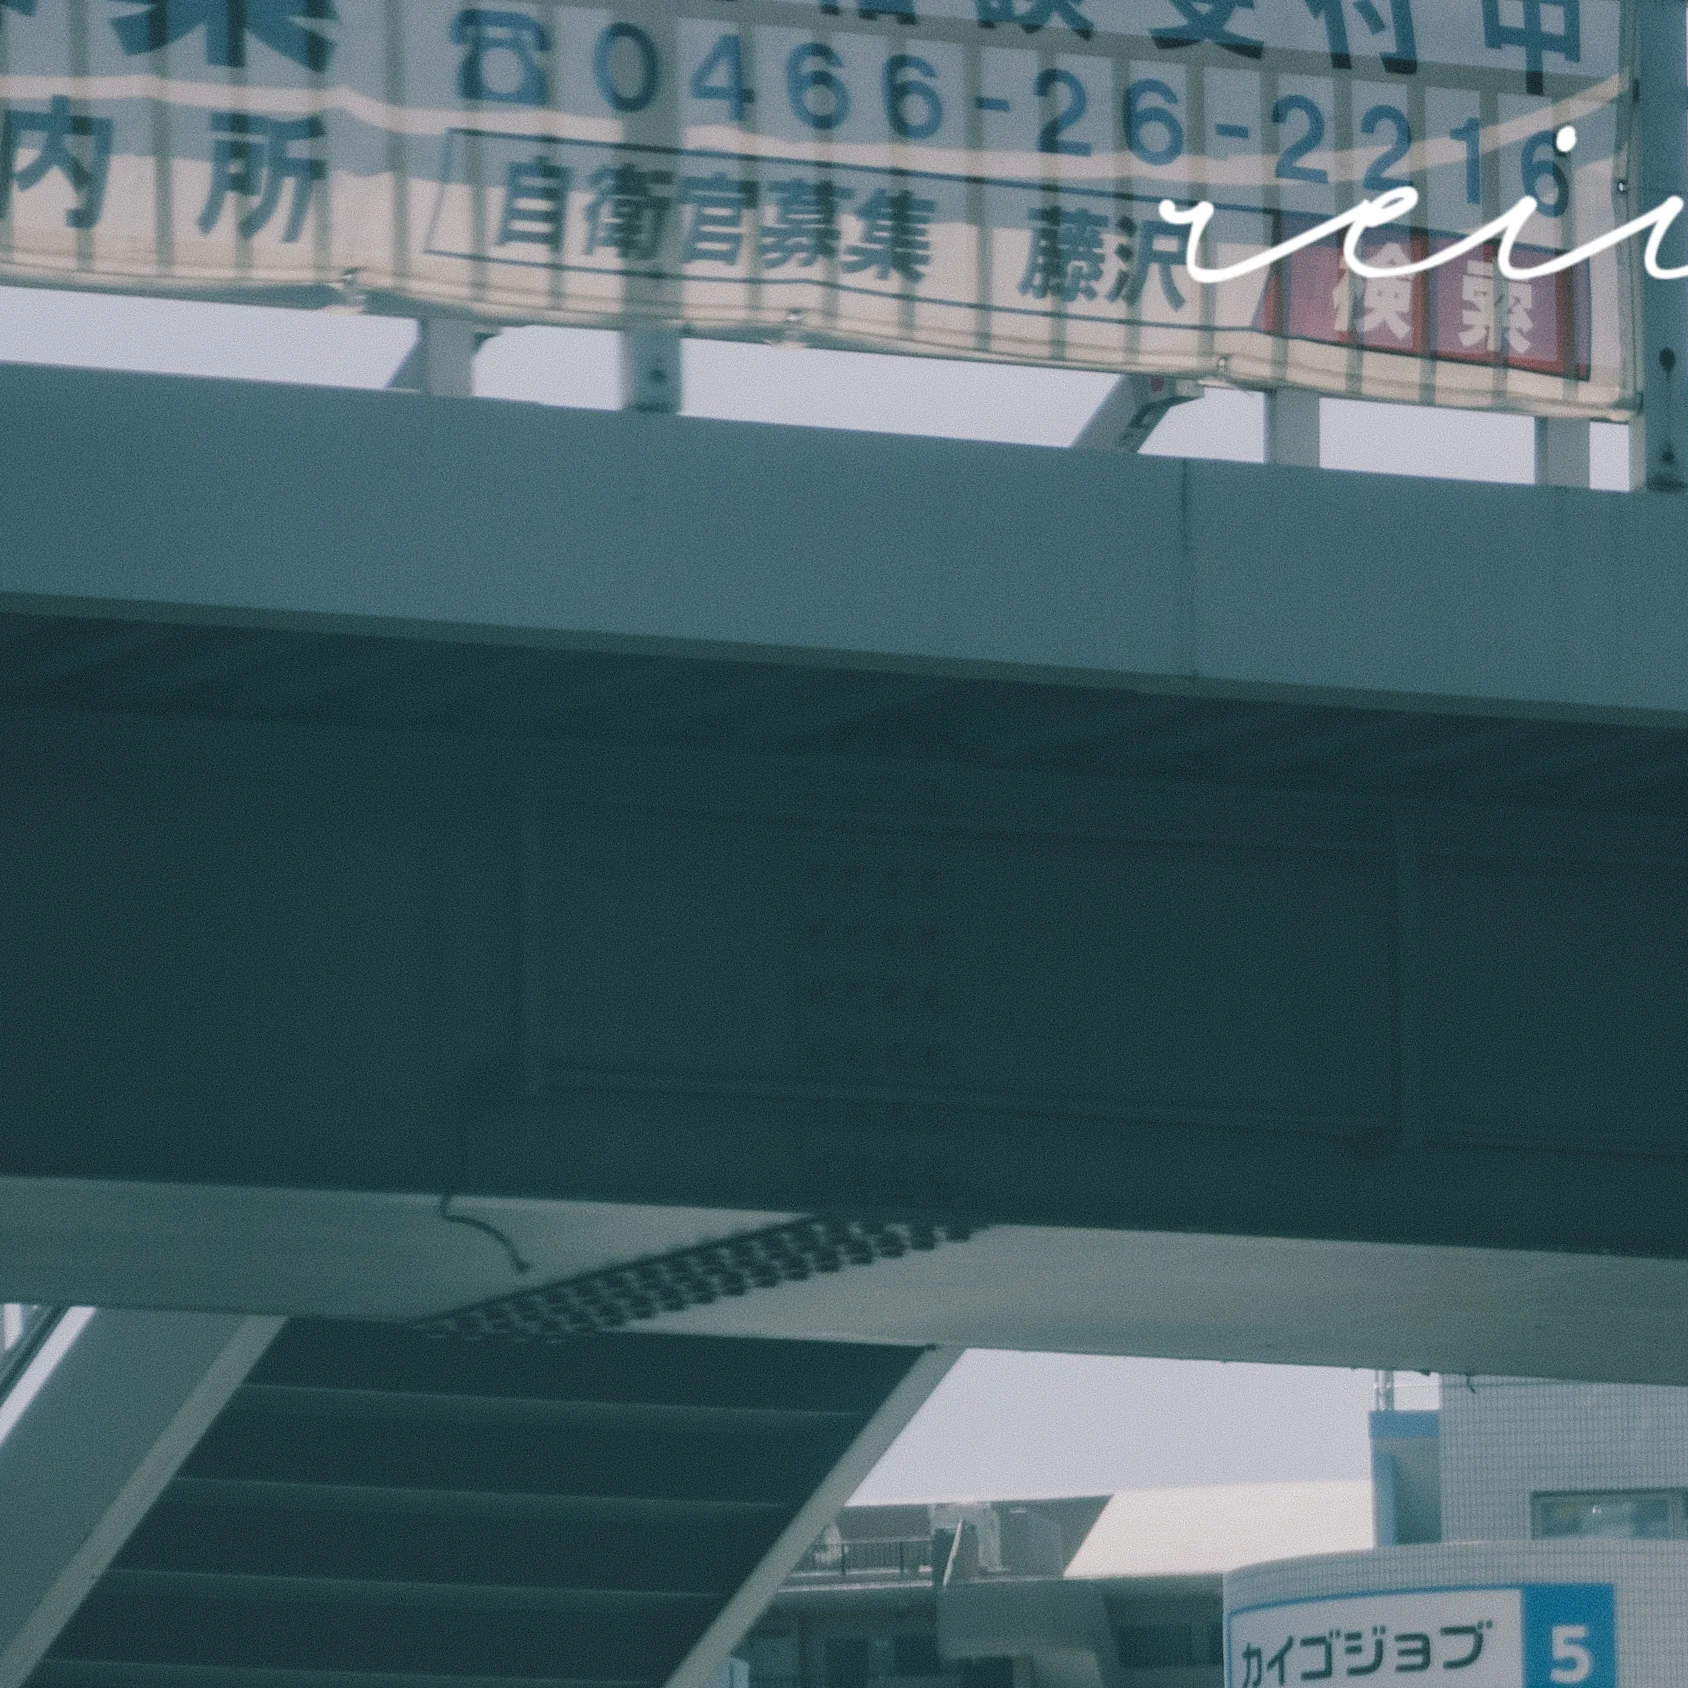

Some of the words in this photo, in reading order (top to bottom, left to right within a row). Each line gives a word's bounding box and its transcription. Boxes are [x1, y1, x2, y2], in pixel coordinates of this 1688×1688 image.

[592, 20, 1570, 218] 0466-26-2216
[494, 154, 936, 286] 自衛官募集
